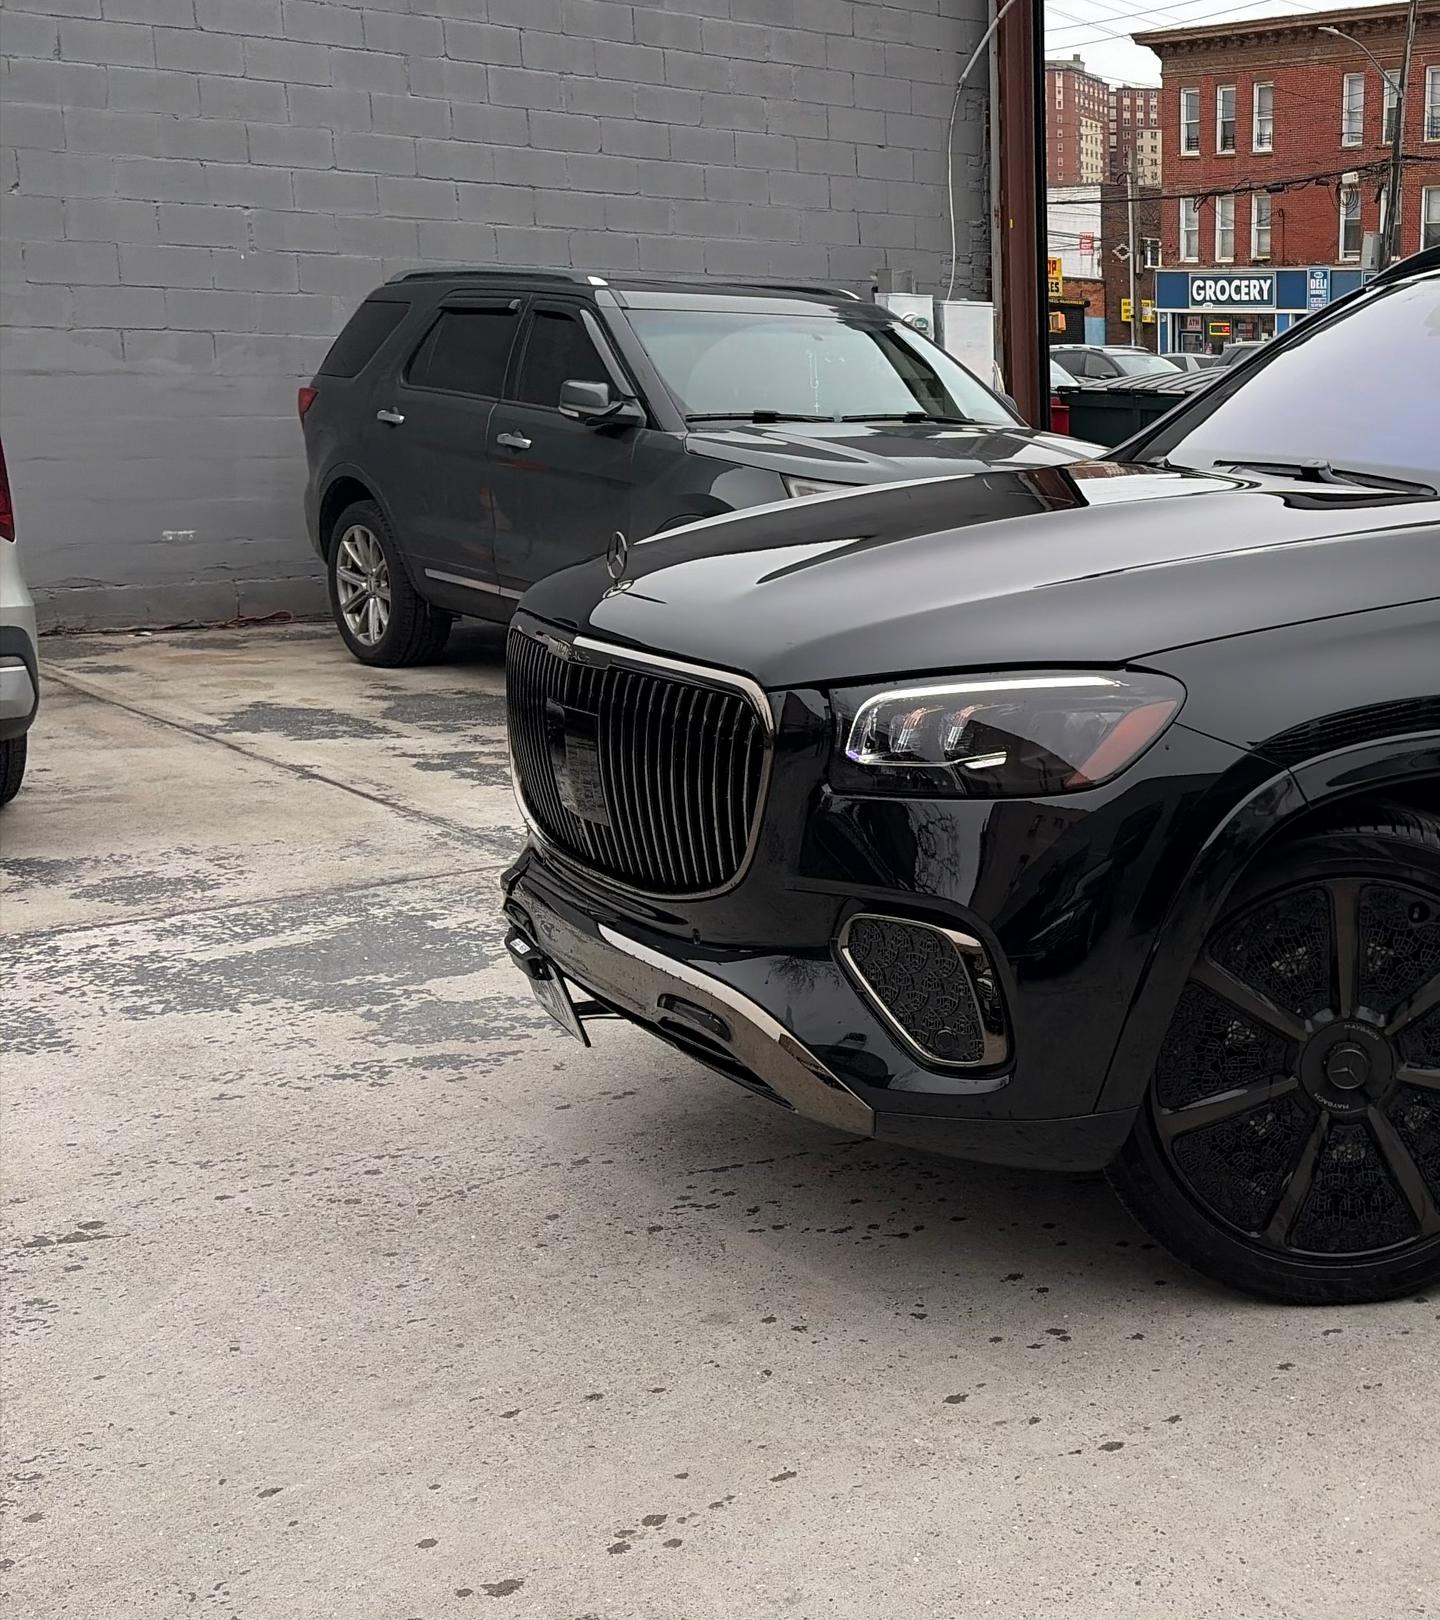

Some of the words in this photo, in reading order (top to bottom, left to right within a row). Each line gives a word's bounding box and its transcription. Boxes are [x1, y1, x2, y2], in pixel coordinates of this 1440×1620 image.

[1192, 279, 1272, 301] GROCERY
[1310, 279, 1327, 289] DELI
[1189, 318, 1200, 326] ATM
[1344, 1023, 1380, 1041] MAYBACH
[1314, 1092, 1350, 1109] MAYBACH
